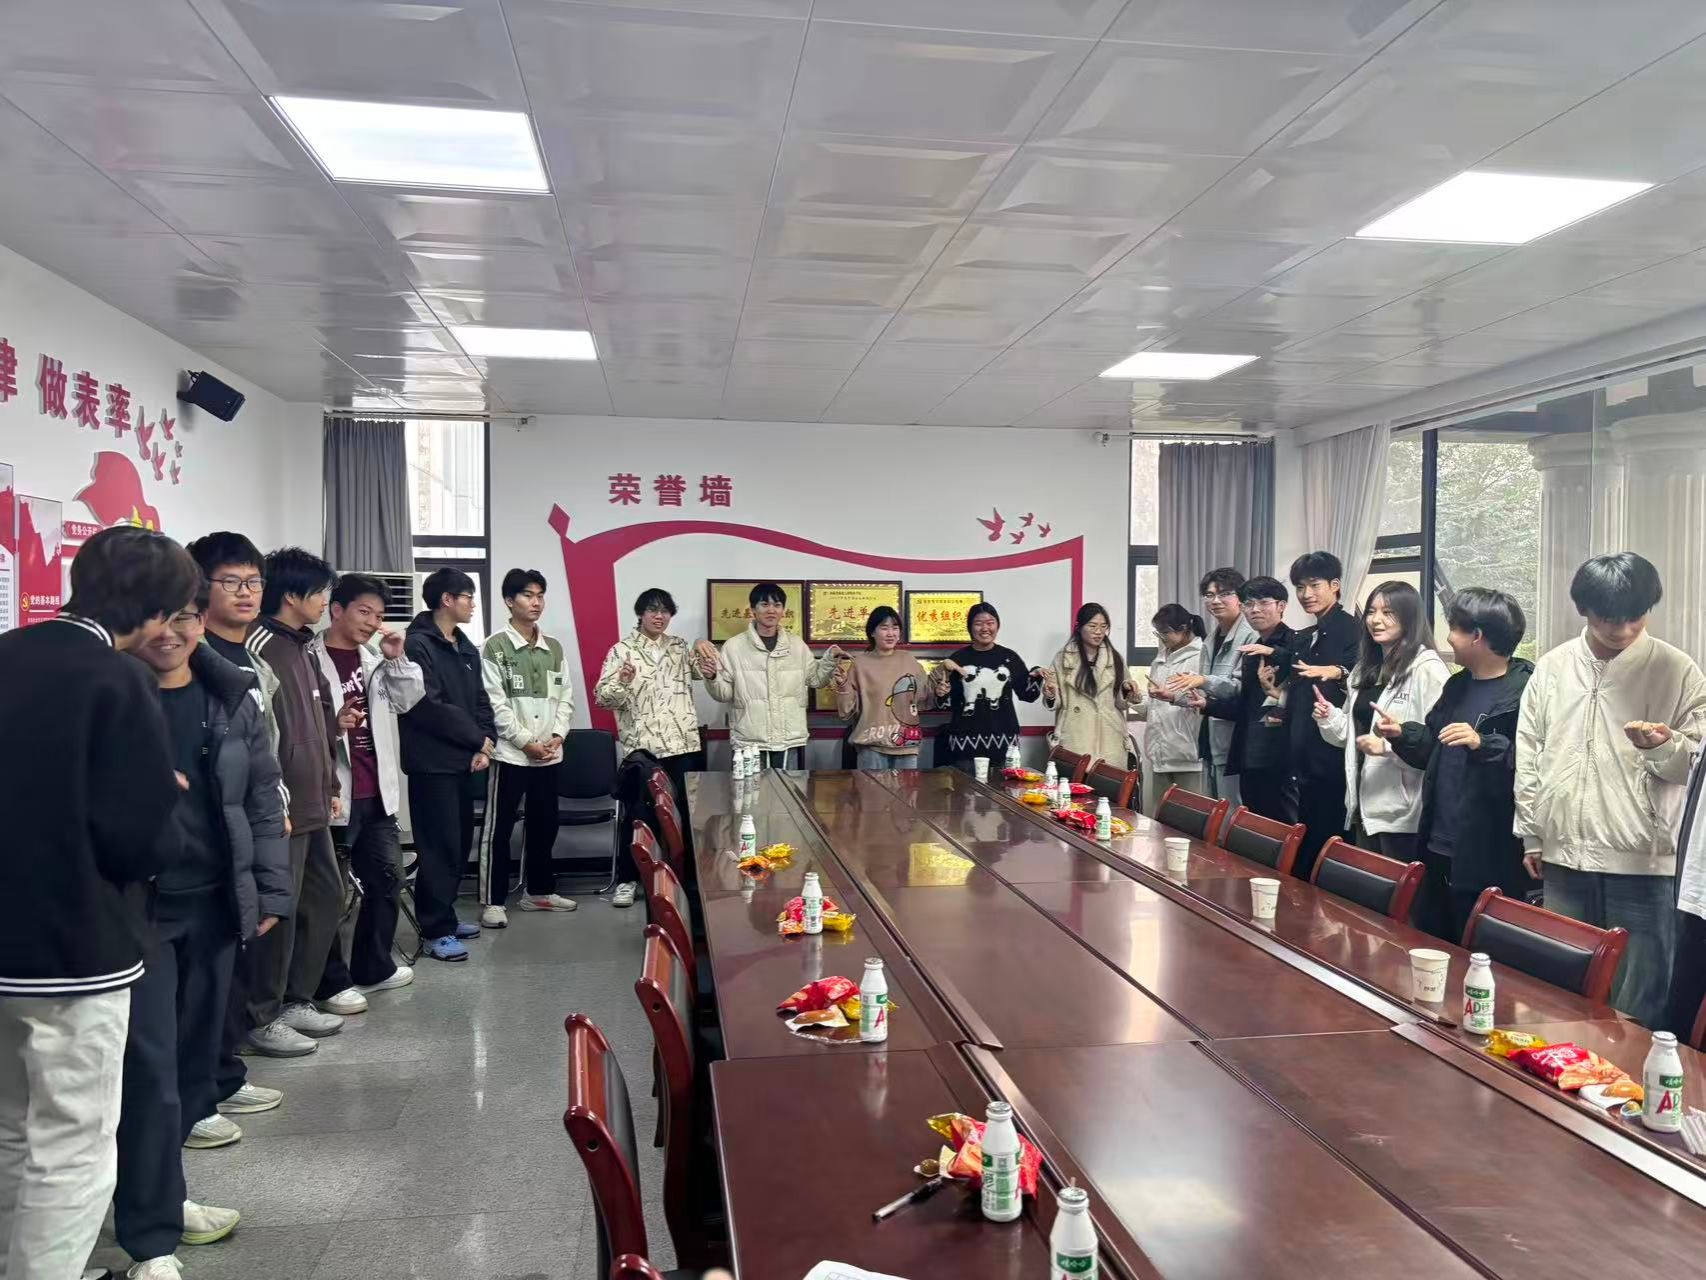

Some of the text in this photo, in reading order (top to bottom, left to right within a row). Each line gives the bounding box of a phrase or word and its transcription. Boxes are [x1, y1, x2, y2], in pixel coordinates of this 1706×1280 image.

[35, 353, 131, 438] 做表率
[608, 473, 732, 507] 荣誉墙
